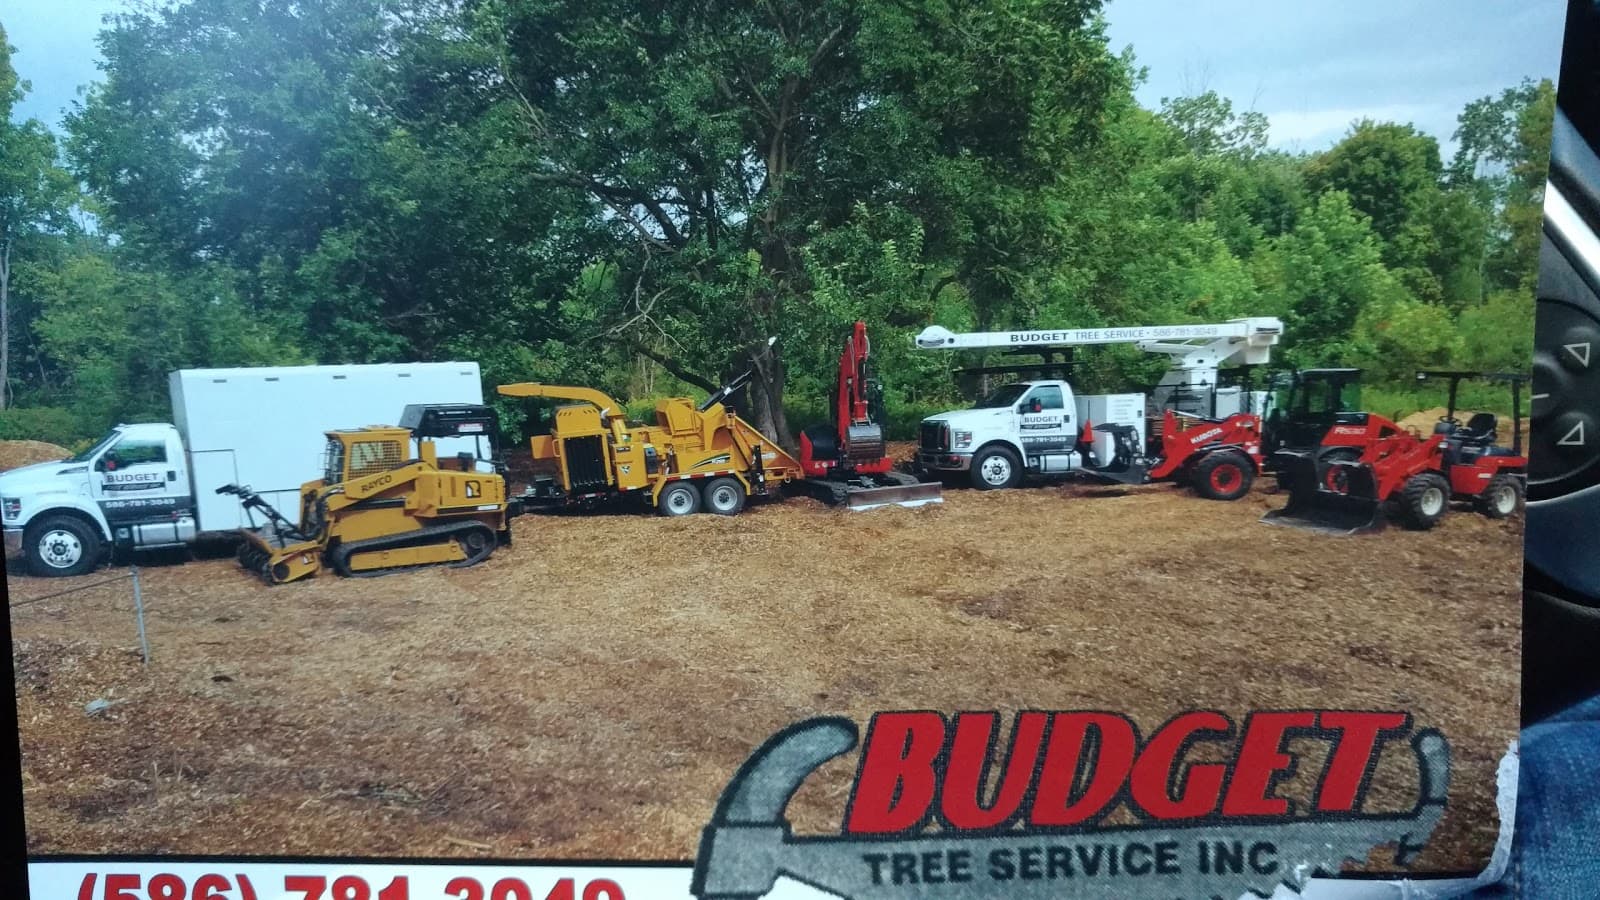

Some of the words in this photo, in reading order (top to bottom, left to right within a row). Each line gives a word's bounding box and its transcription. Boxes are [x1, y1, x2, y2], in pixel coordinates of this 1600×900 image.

[1010, 332, 1069, 343] BUDGET
[1075, 331, 1100, 341] TREE
[1104, 329, 1144, 339] SERVICE
[1024, 415, 1058, 423] BUDGET
[106, 472, 159, 483] BUDGET
[361, 474, 392, 493] RAYCO
[845, 709, 1408, 834] BUDGET
[863, 850, 973, 885] TREE
[988, 843, 1180, 881] SERVICE
[1200, 842, 1278, 876] INC
